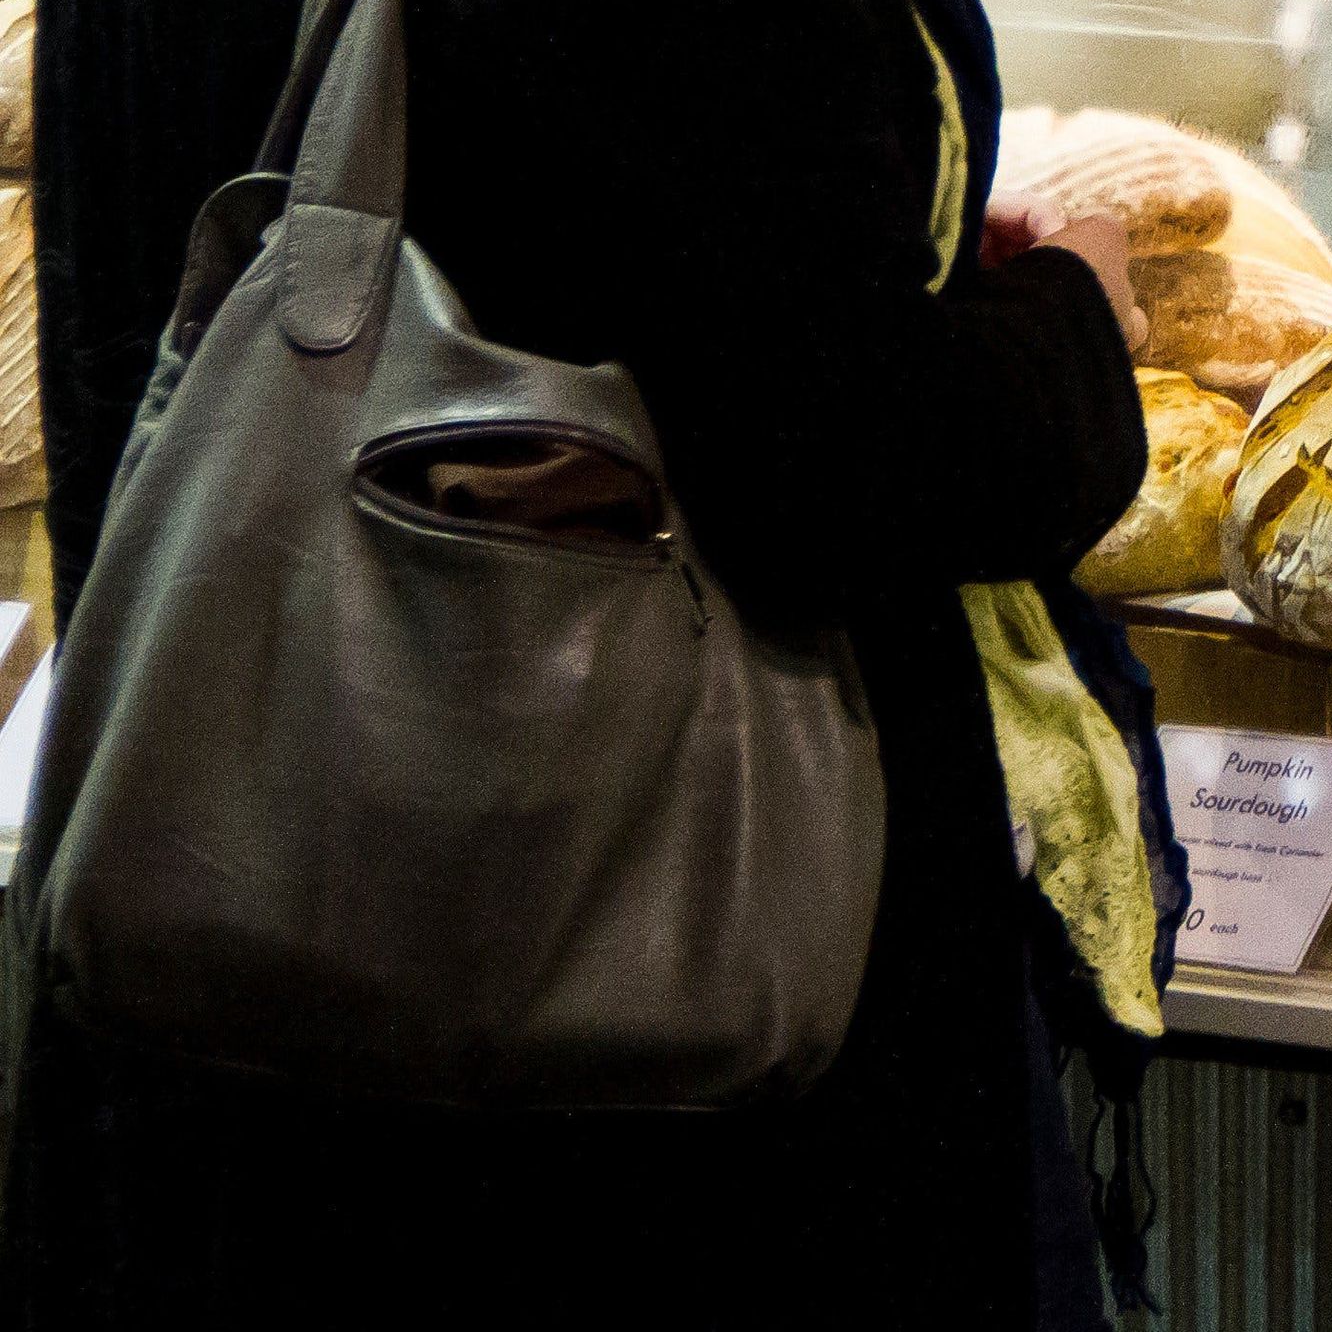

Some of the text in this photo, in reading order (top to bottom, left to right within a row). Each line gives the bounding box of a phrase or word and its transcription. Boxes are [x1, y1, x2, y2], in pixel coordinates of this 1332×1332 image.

[1221, 750, 1314, 782] Pumpkin
[1189, 787, 1309, 824] Sourdough
[1183, 908, 1240, 935] 0 each
